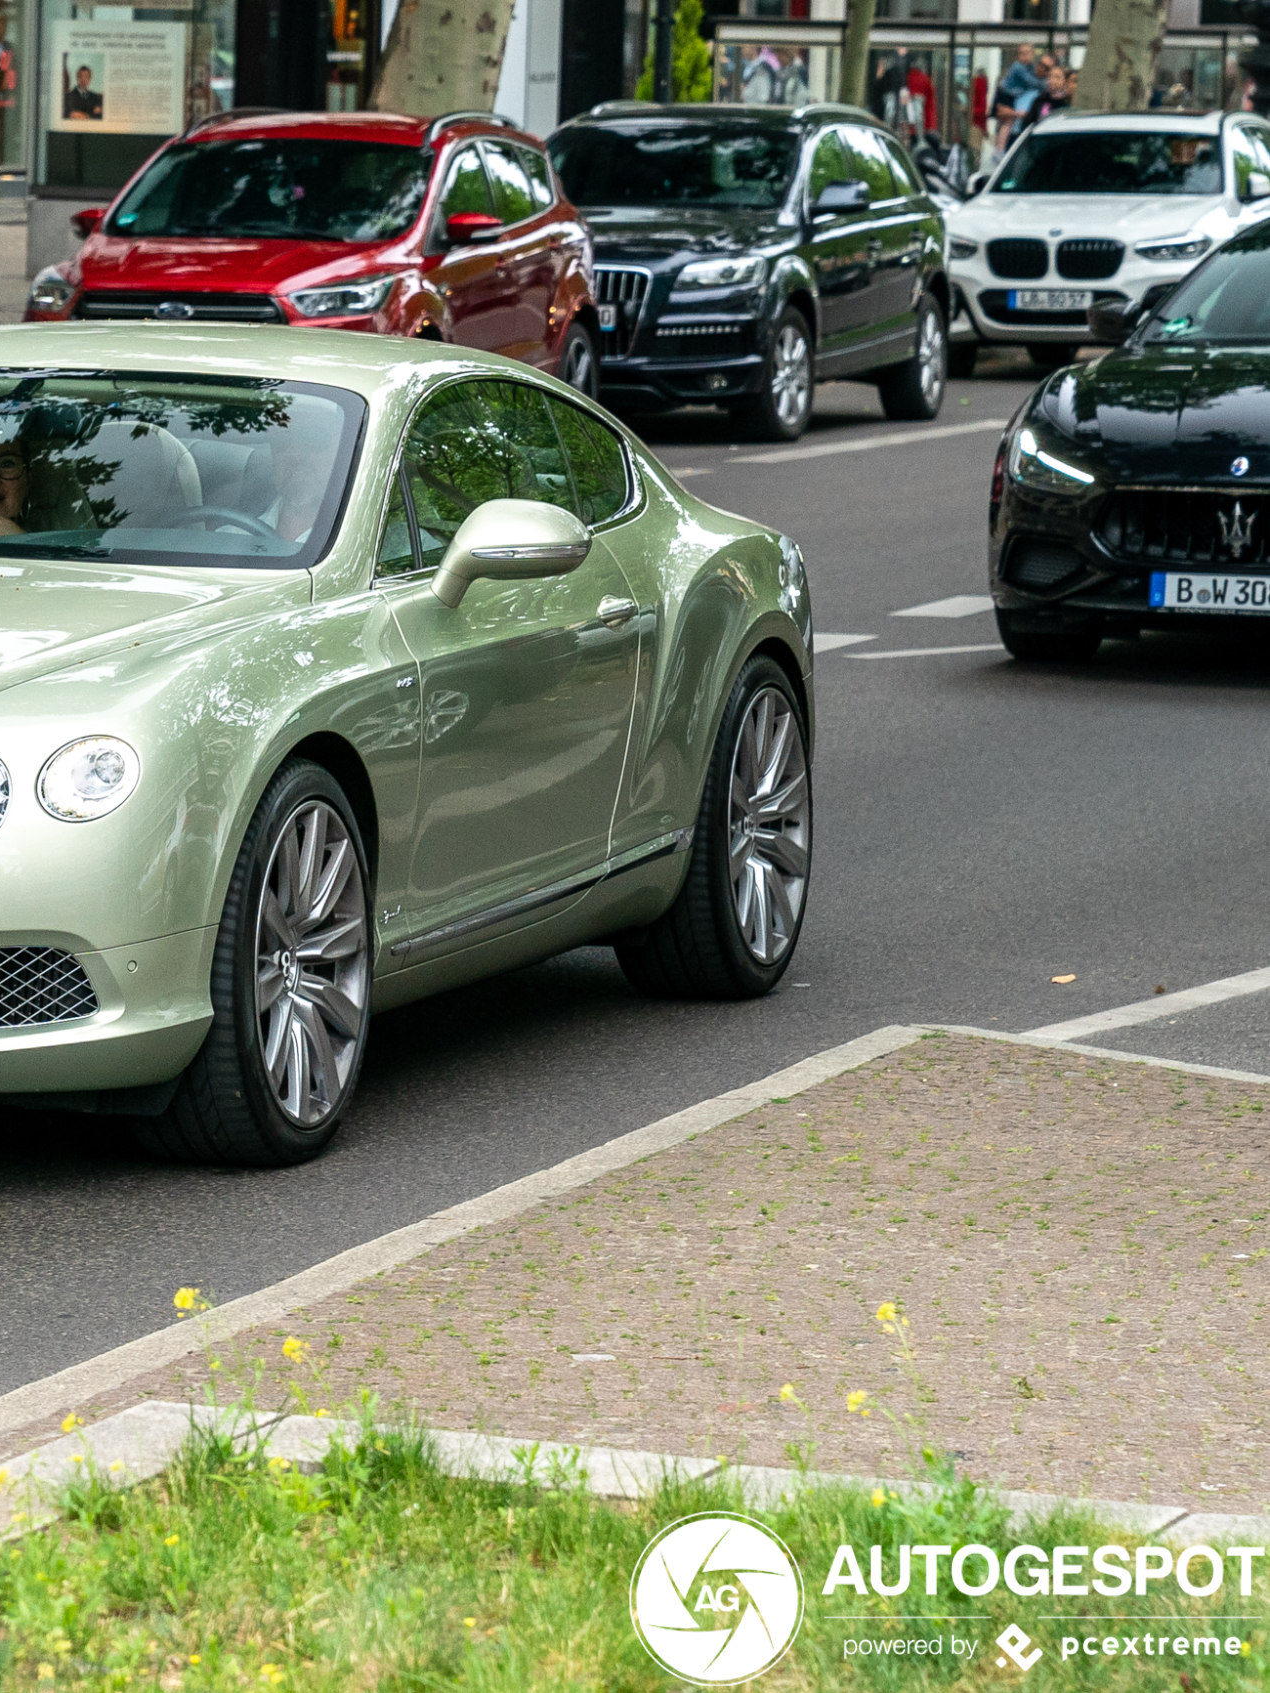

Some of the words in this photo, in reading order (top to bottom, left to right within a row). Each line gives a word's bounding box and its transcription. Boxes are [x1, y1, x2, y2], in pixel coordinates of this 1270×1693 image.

[1177, 577, 1193, 603] B
[1212, 578, 1228, 604] W
[1234, 580, 1270, 606] 30
